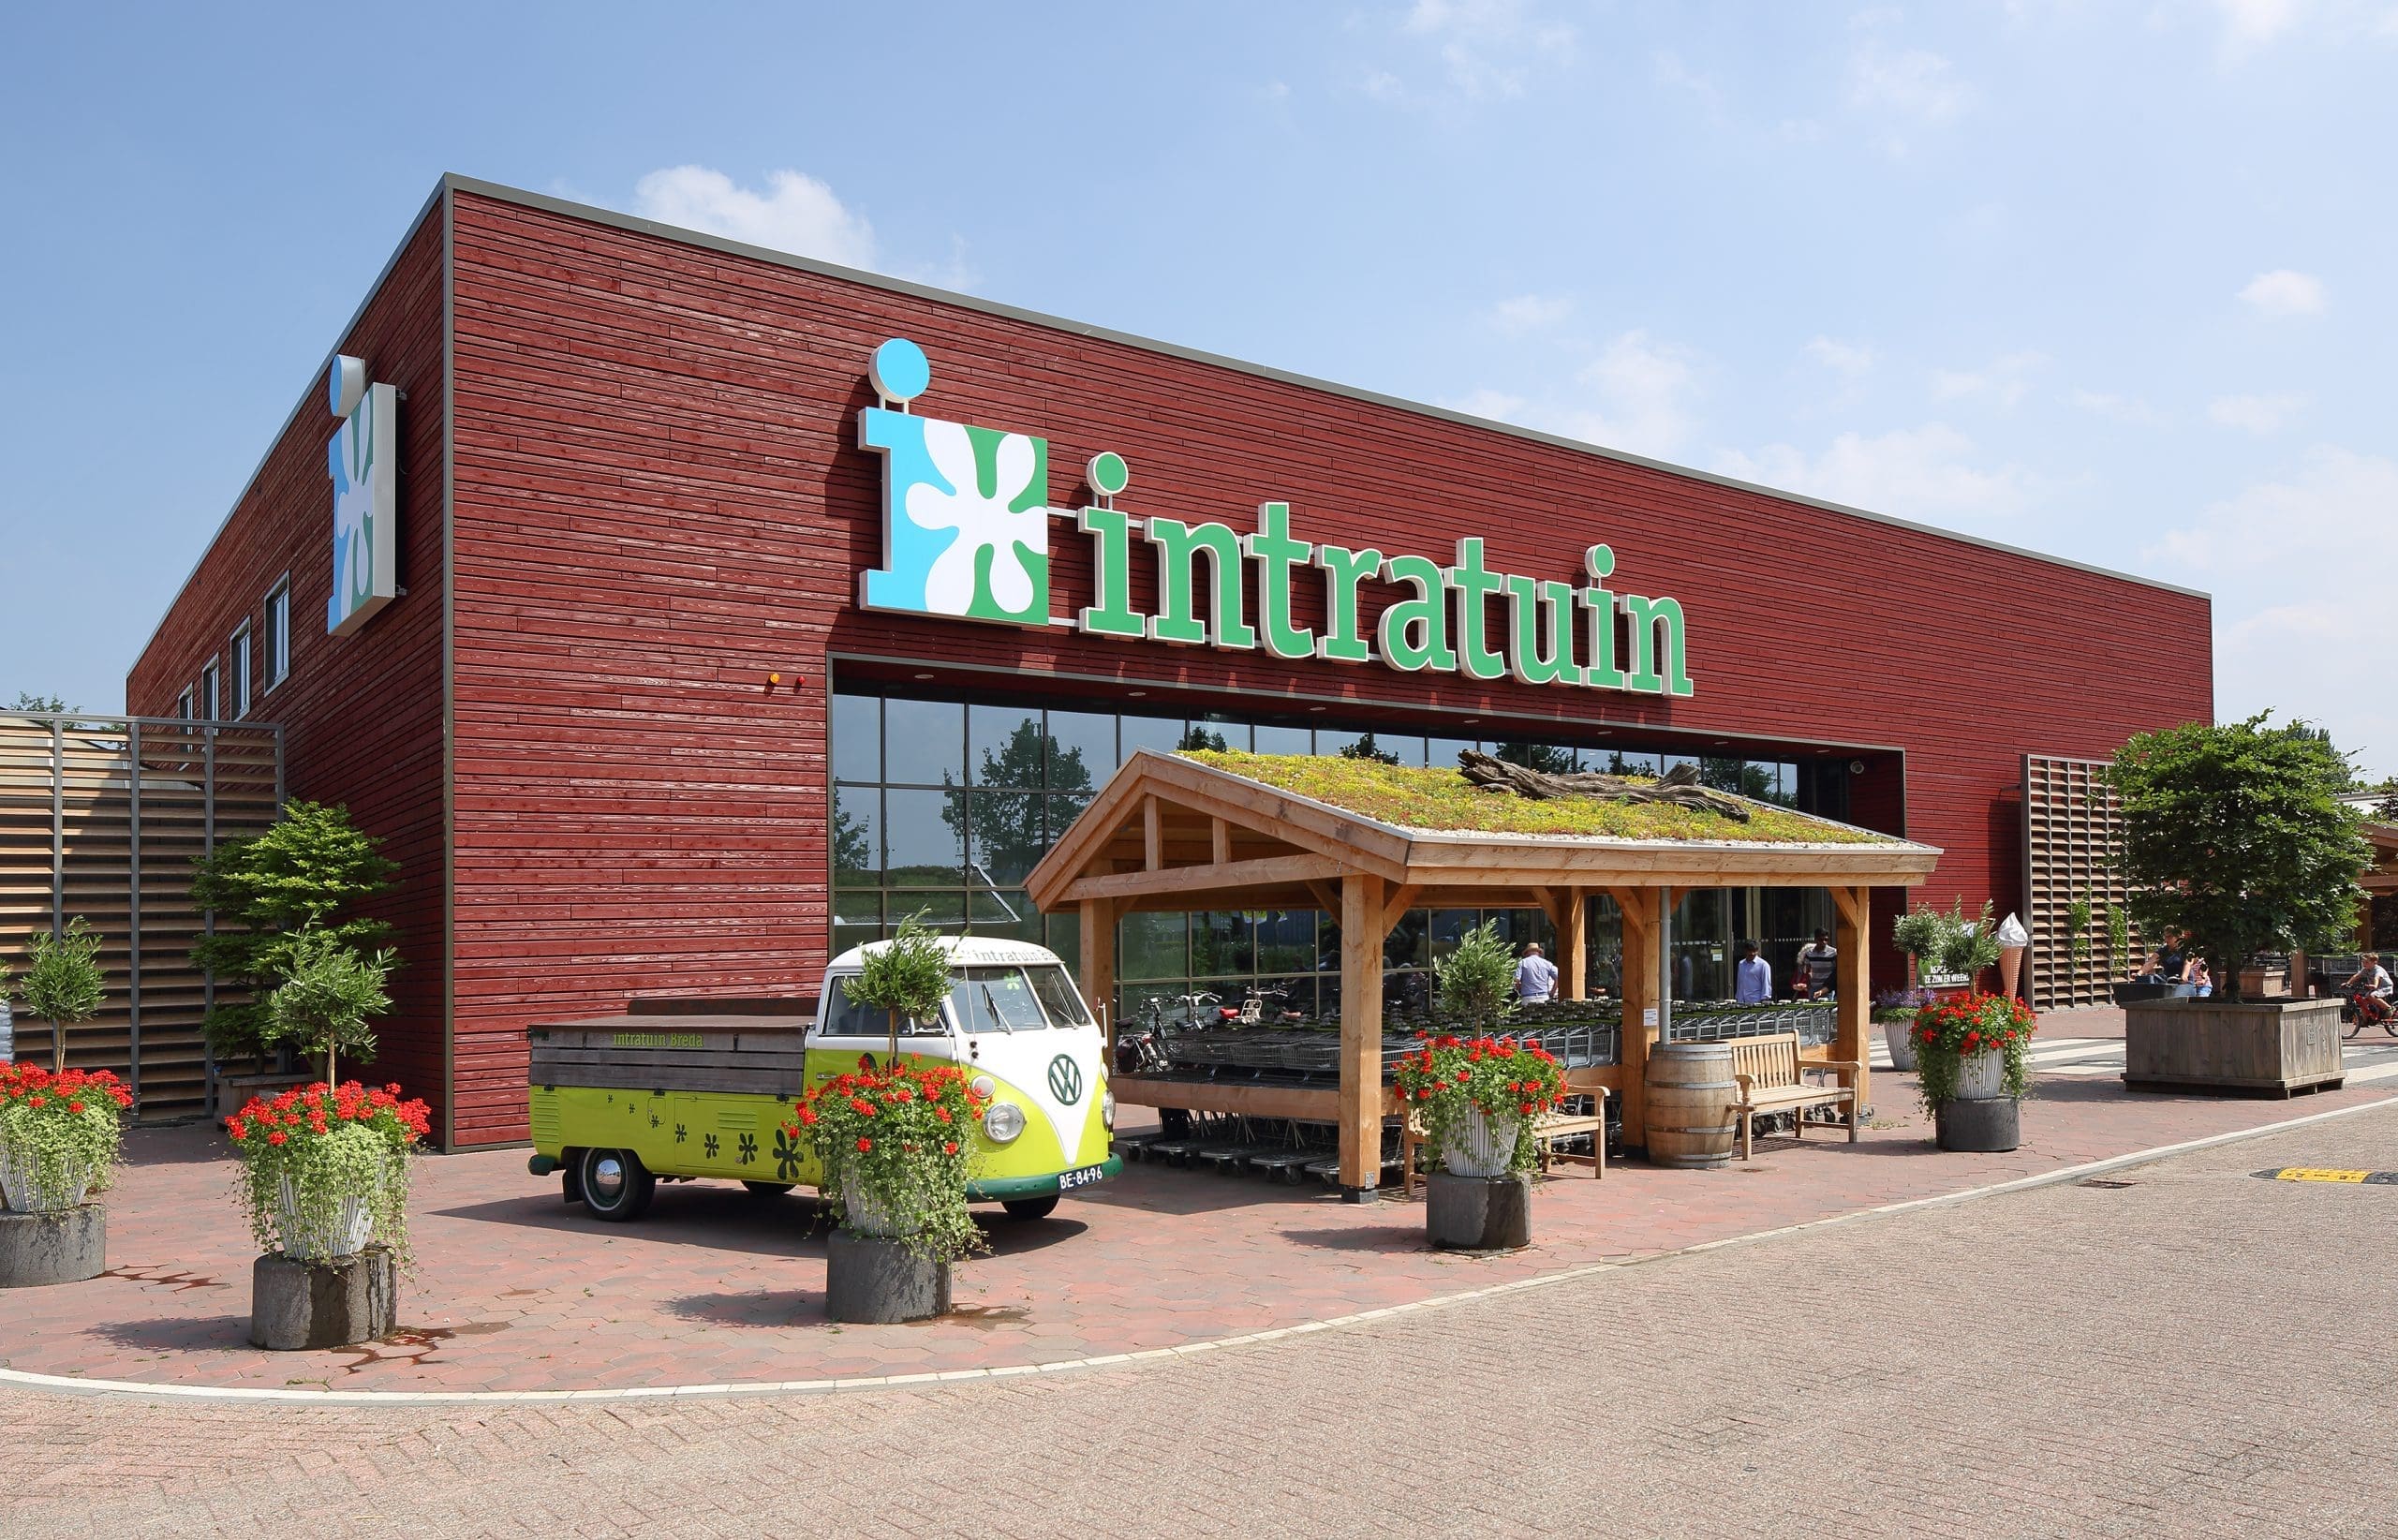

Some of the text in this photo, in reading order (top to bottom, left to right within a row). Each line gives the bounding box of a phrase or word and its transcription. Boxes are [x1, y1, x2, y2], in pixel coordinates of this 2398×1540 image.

[1077, 452, 1694, 697] intratuin
[614, 1032, 703, 1047] intratuin Breda
[1059, 1165, 1103, 1189] BE-84-96
